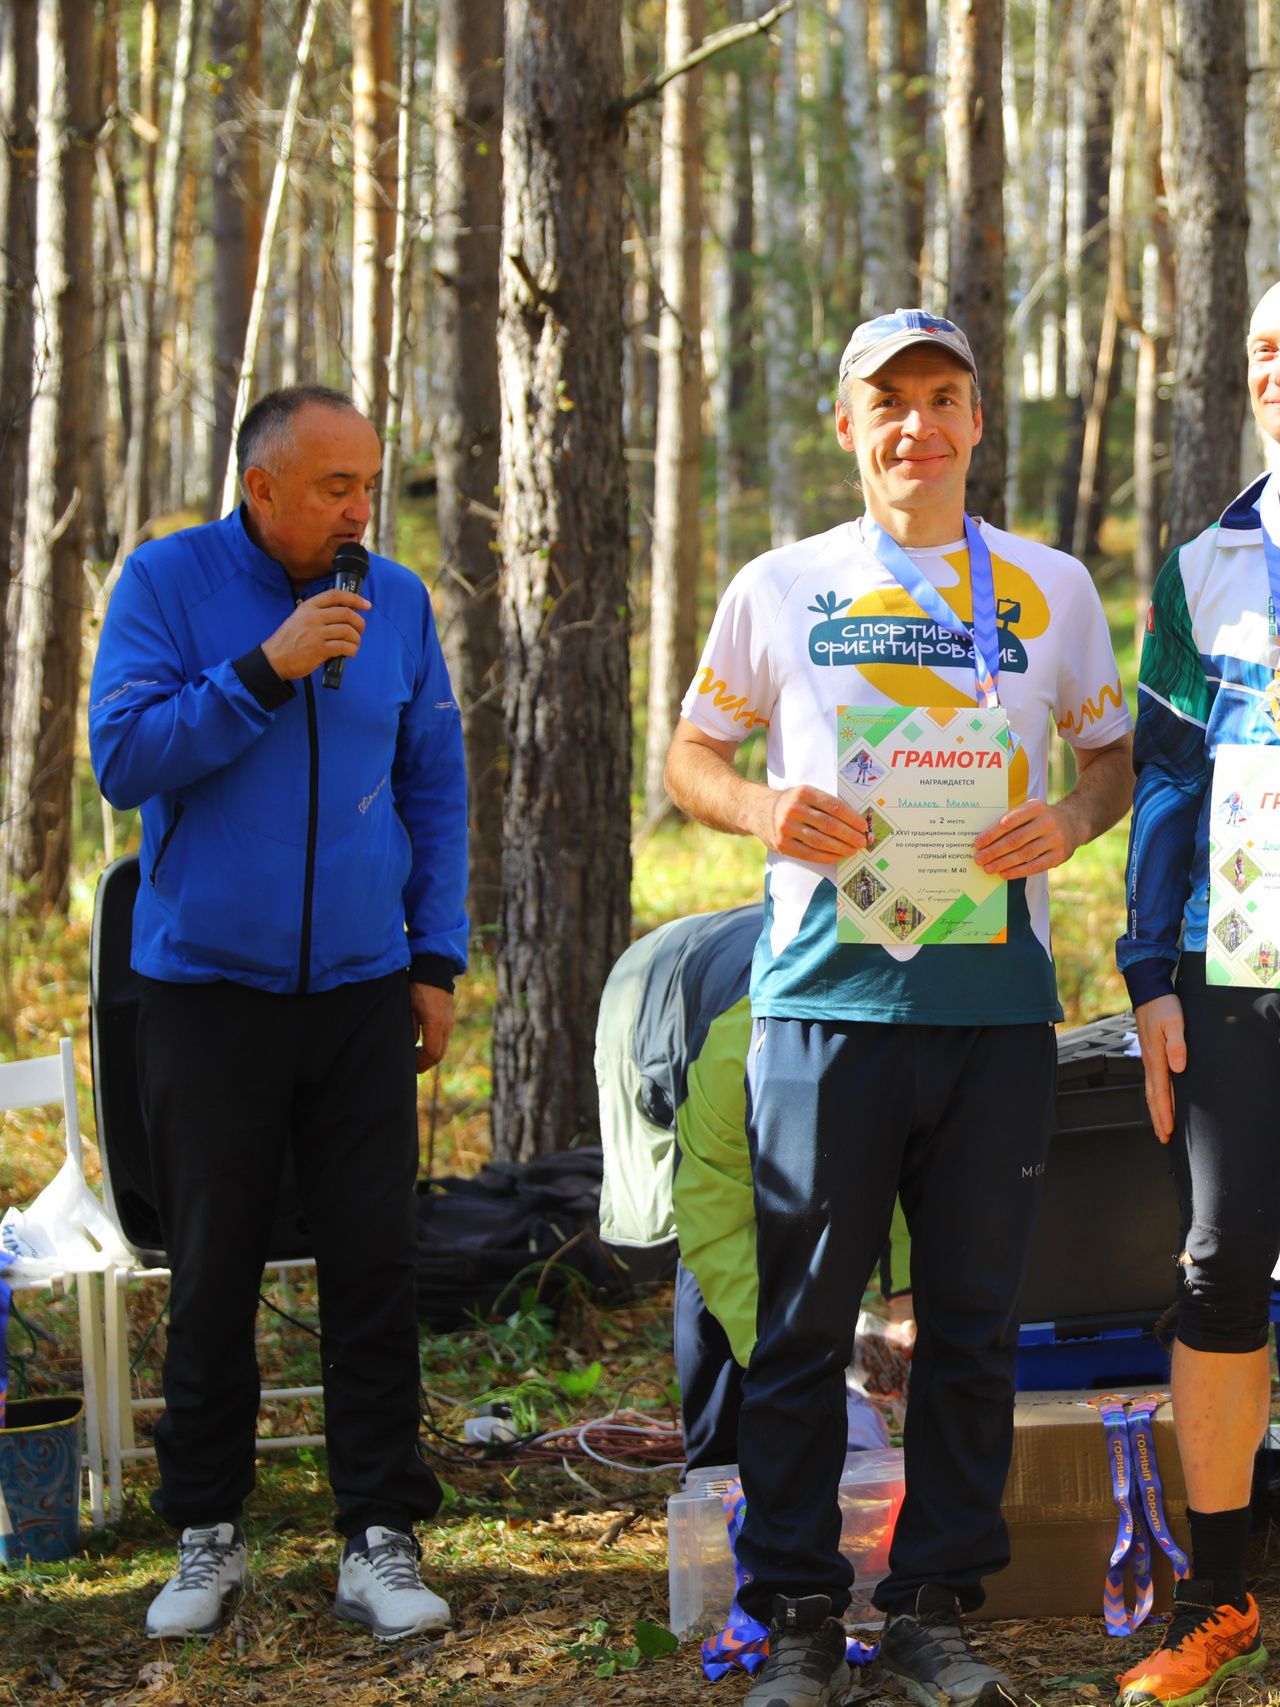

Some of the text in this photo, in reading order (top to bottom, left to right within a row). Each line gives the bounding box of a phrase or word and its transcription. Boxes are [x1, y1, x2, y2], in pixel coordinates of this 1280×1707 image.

[841, 623, 975, 643] СПОРТИВ
[814, 640, 1018, 669] ОРИЕНТИРОВАИЕ
[891, 750, 1002, 769] ГРАМОТА
[1113, 1439, 1125, 1488] ГОРНЫЙ
[1136, 1433, 1153, 1482] ГОРНЫЙ
[1146, 1486, 1162, 1532] КОРОЛЬ
[1118, 1492, 1133, 1534] КОРОЬ
